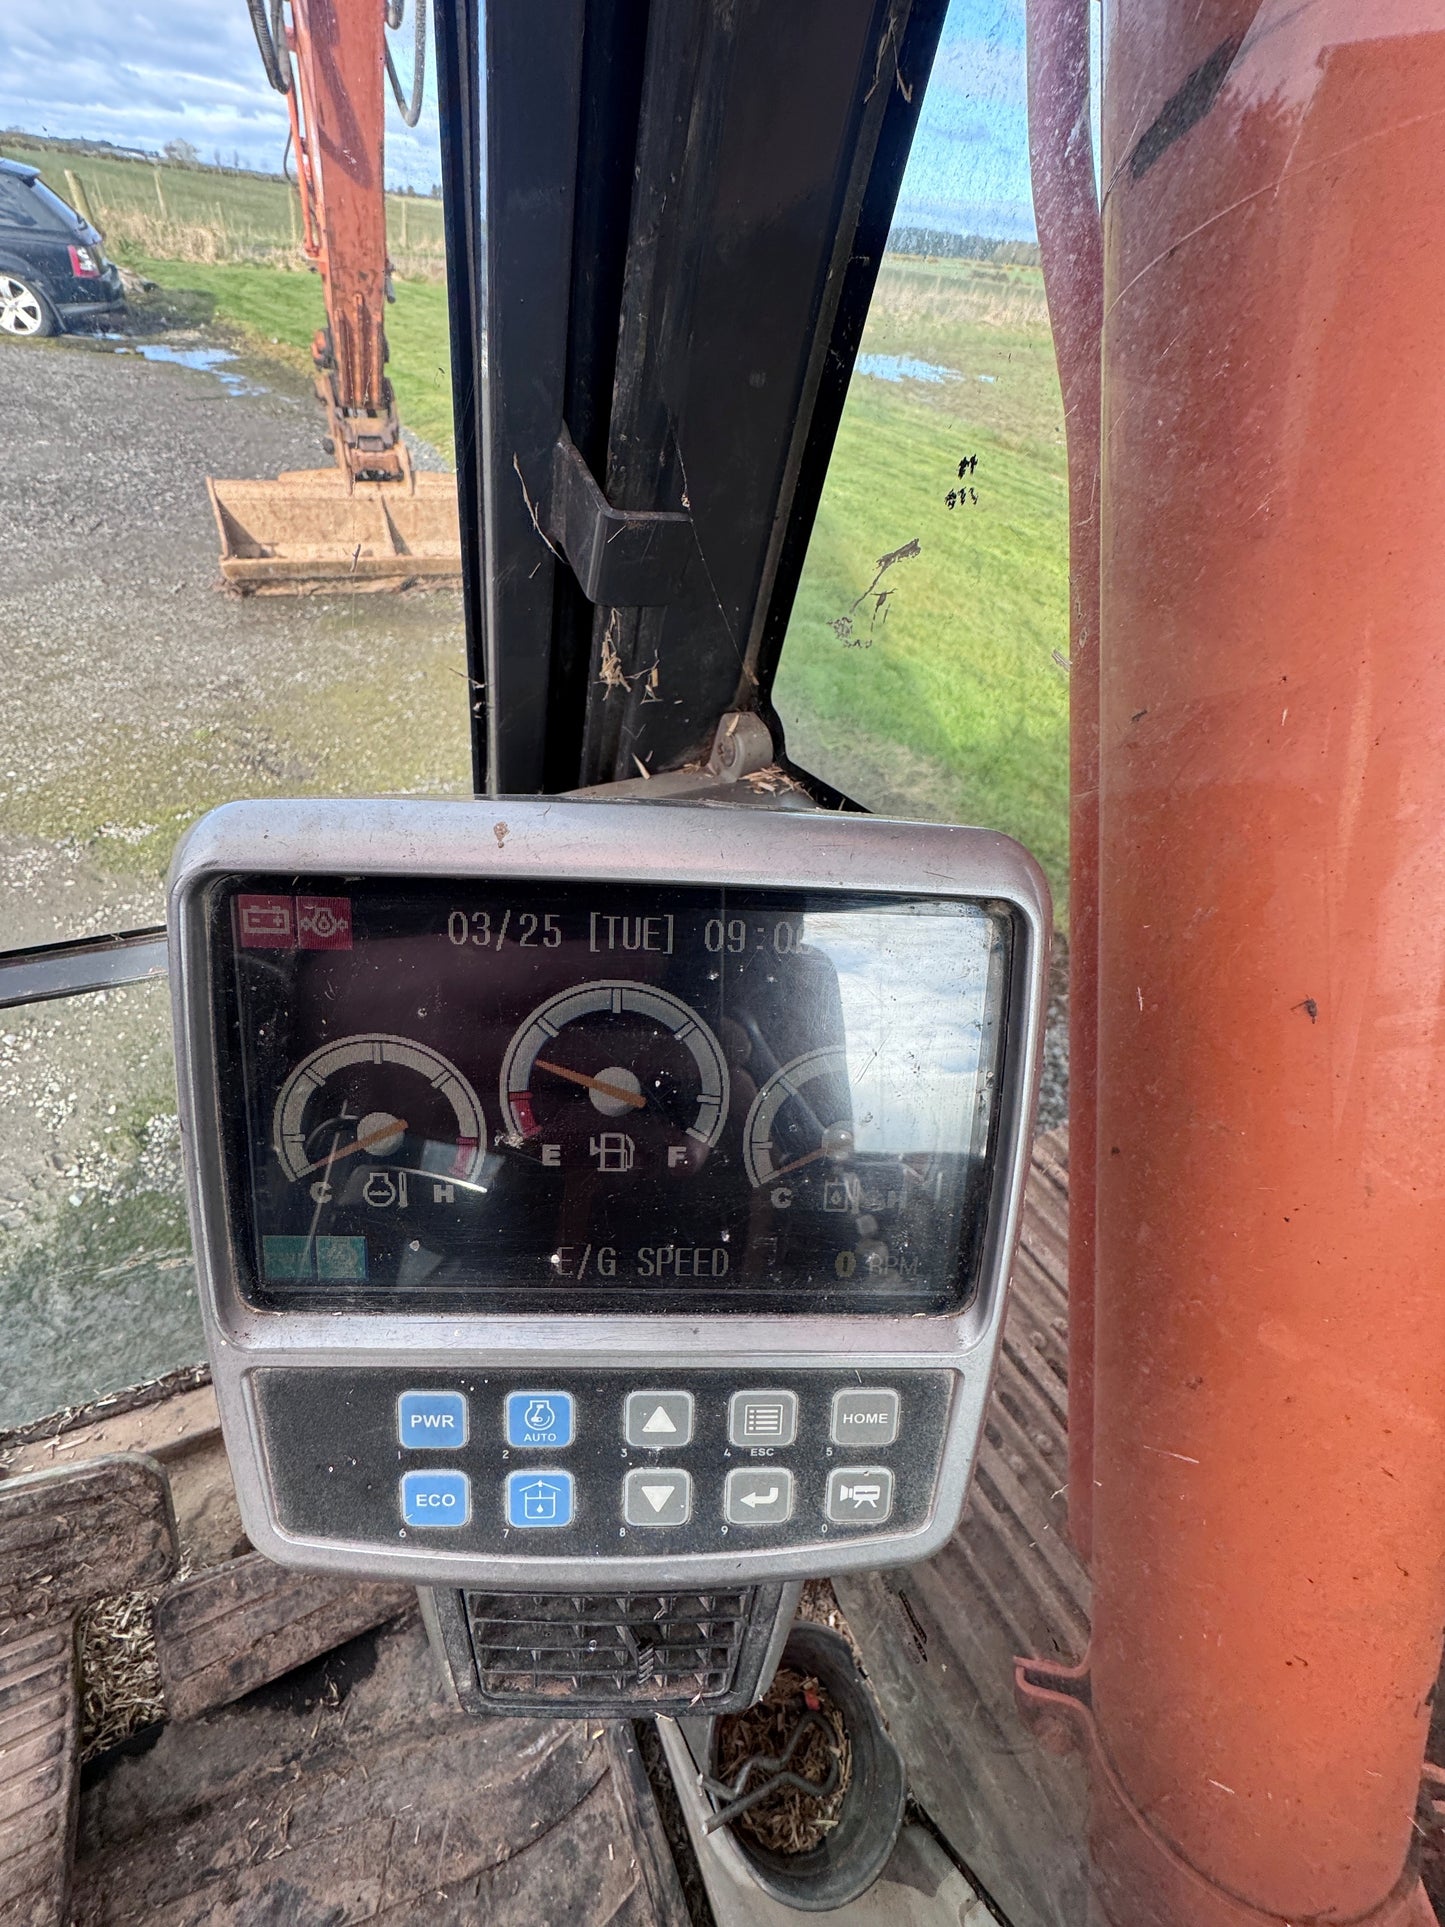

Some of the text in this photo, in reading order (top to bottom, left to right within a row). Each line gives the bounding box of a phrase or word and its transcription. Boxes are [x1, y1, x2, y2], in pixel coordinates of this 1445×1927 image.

[448, 910, 562, 952] 03/25
[590, 911, 675, 954] [TUE]
[542, 1144, 562, 1166] E
[667, 1146, 687, 1168] F
[310, 1182, 332, 1204] C
[433, 1184, 455, 1204] H
[771, 1187, 792, 1208] C
[557, 1243, 616, 1280] E/G
[637, 1247, 729, 1277] SPEED
[835, 1251, 856, 1277] 0
[411, 1414, 455, 1428] PWR
[843, 1413, 888, 1425] HOME
[523, 1432, 557, 1442] AUTO
[502, 1450, 510, 1459] 2
[620, 1449, 628, 1458] 3
[724, 1448, 732, 1457] 4
[750, 1448, 774, 1457] ESC
[826, 1447, 833, 1456] 5
[416, 1494, 456, 1507] ECO
[399, 1529, 406, 1538] 6
[503, 1529, 509, 1538] 7
[619, 1527, 626, 1537] 8
[721, 1526, 728, 1535] 9
[821, 1524, 828, 1533] 0
